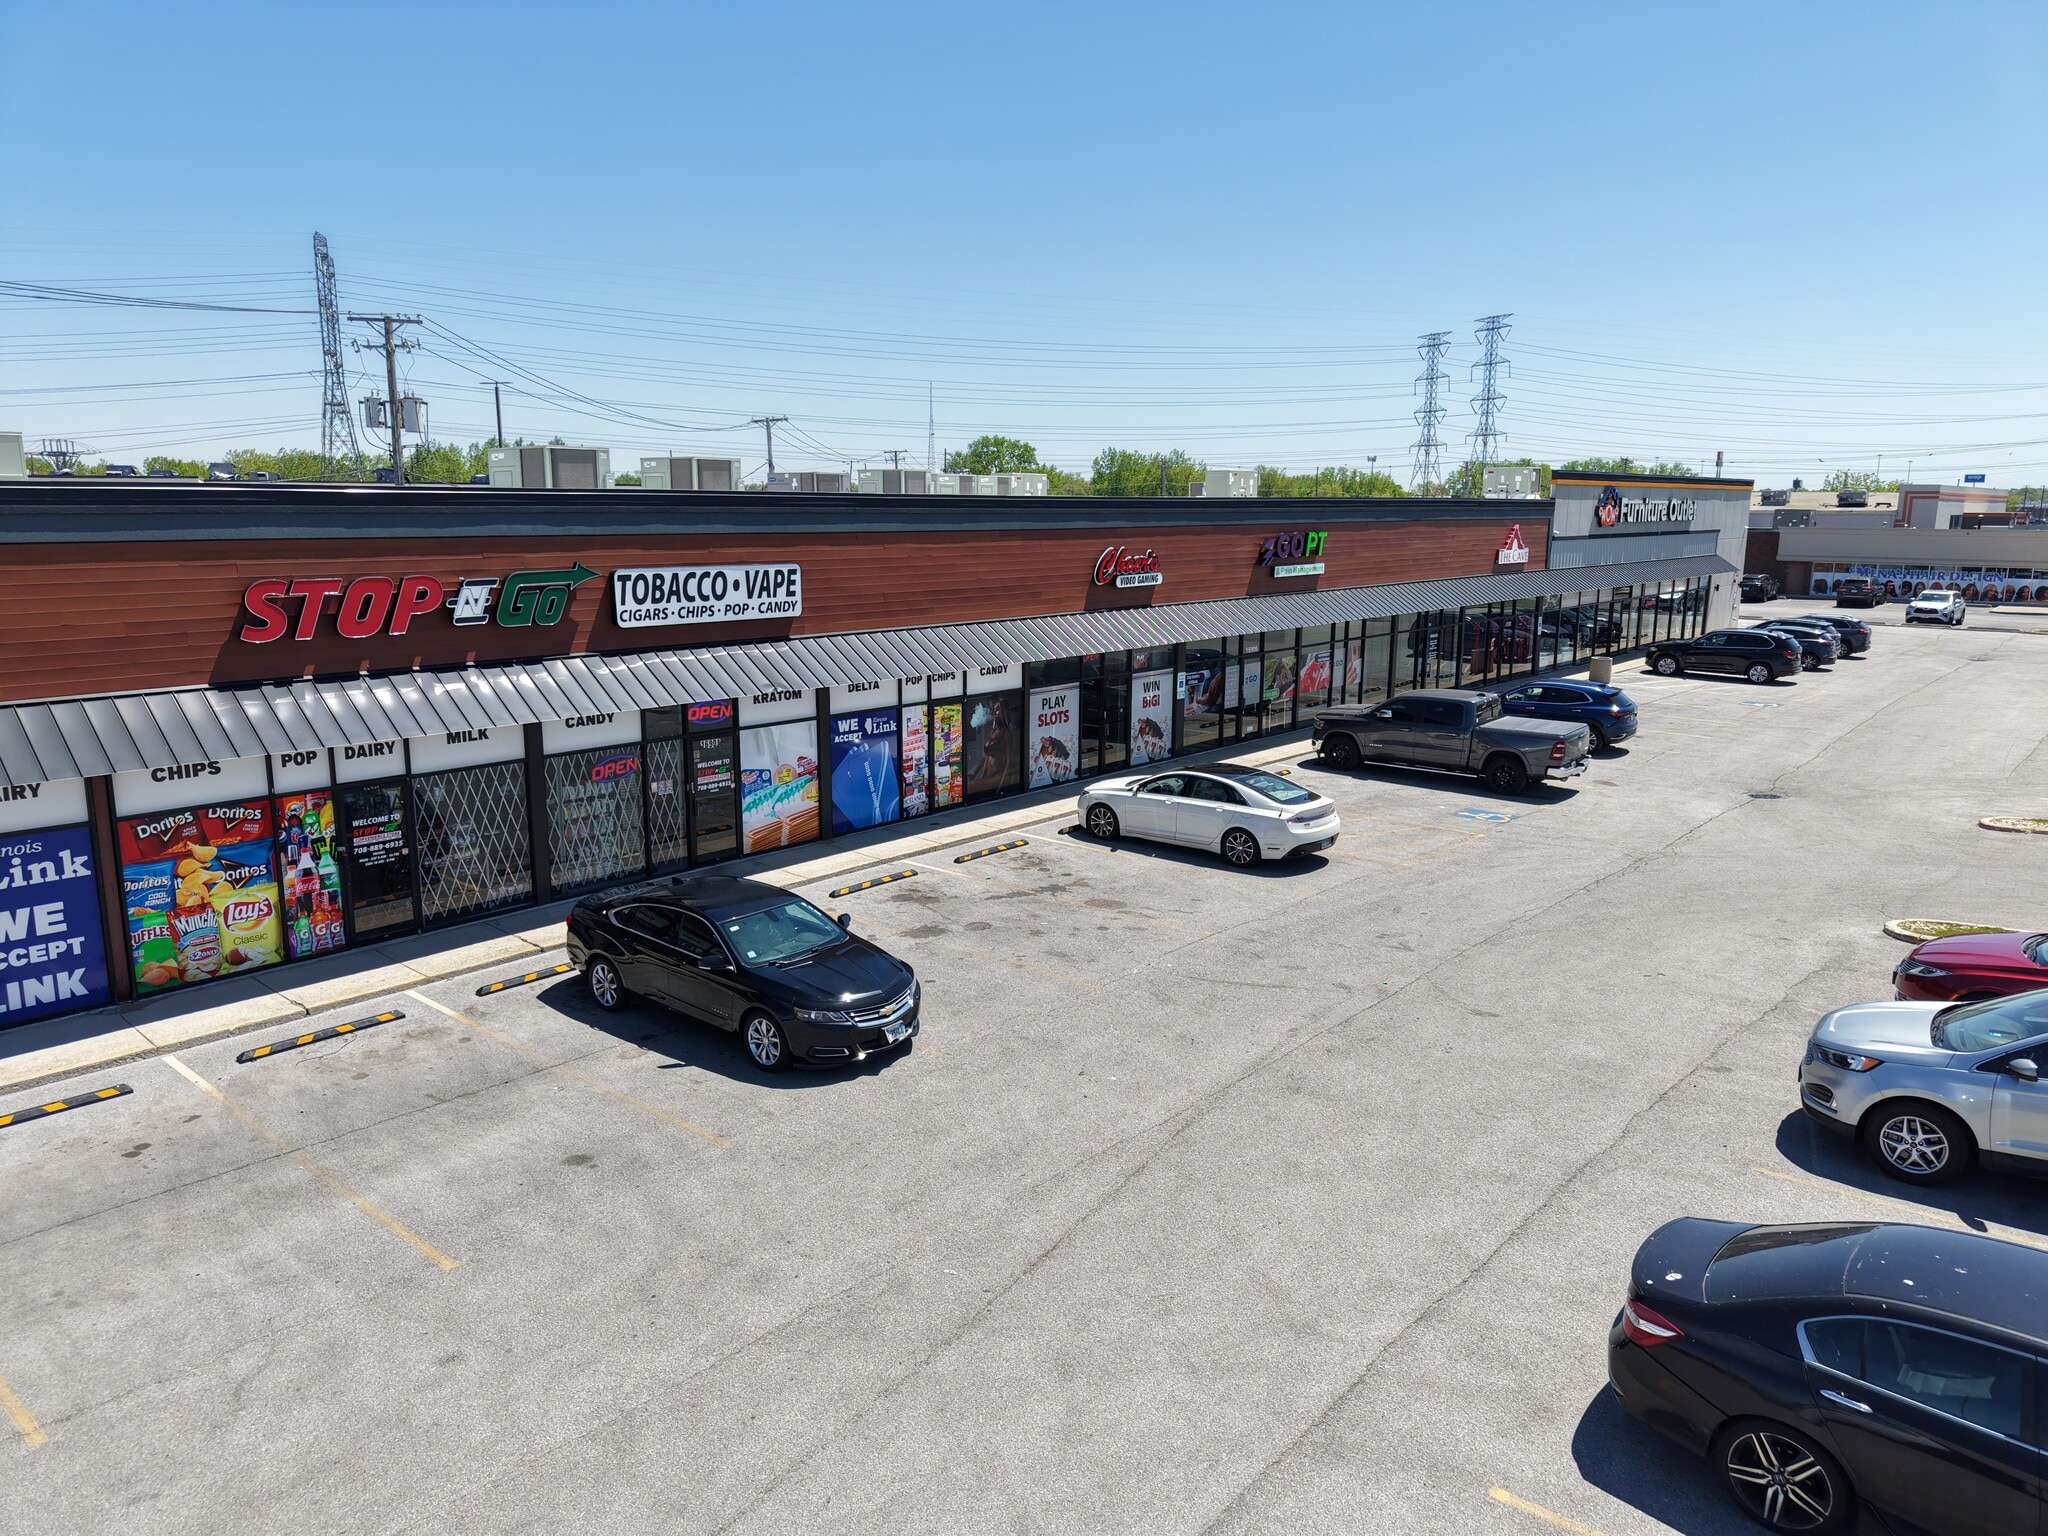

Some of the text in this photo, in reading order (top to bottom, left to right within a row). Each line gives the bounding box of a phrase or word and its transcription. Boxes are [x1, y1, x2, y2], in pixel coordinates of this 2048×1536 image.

[1621, 498, 1697, 523] Furniture Outlet
[1500, 549, 1528, 562] THE CAVE
[1281, 566, 1292, 574] Pain
[1293, 564, 1324, 574] Management
[1910, 569, 1945, 581] HAIR
[1950, 570, 2005, 583] DESIGN
[617, 568, 798, 606] TOBACCO VAPE
[1120, 574, 1159, 586] VIDEO GAMING
[240, 575, 444, 644] STOP
[619, 600, 798, 623] CIGARS CHIPS POP CANDY
[932, 671, 957, 683] CHIPS
[980, 664, 1009, 677] CANDY
[848, 680, 880, 693] DELTA
[905, 675, 923, 686] POP
[1142, 680, 1160, 693] WIN
[753, 690, 802, 705] KRATOM
[1041, 695, 1067, 710] PLAY
[687, 703, 732, 721] OPEN
[1038, 710, 1070, 728] SLOTS
[565, 712, 616, 729] CANDY
[837, 718, 859, 733] WE
[872, 720, 897, 734] Link
[447, 728, 489, 745] MILK
[834, 732, 863, 743] ACCEPT
[344, 740, 396, 760] DAIRY
[281, 750, 317, 768] POP
[697, 759, 722, 768] WELCOME
[151, 760, 222, 783] CHIPS
[591, 757, 638, 781] OPEN
[697, 767, 715, 777] STOP
[0, 782, 41, 802] IRY
[208, 807, 262, 820] Doritos
[352, 813, 400, 827] WELCOME TO
[137, 812, 193, 839] Doritos
[353, 825, 378, 837] STOP
[0, 840, 42, 858] nois
[353, 840, 404, 854] 708-889-6935
[124, 876, 170, 892] Doritos
[144, 897, 171, 907] RANCH
[148, 891, 168, 900] COOL
[227, 900, 270, 925] Lay's
[0, 901, 67, 944] WE
[174, 908, 218, 937] Muncho
[315, 923, 326, 935] G
[331, 922, 340, 933] G
[132, 926, 171, 946] UFFLES
[233, 933, 268, 946] Classic
[300, 929, 309, 938] G
